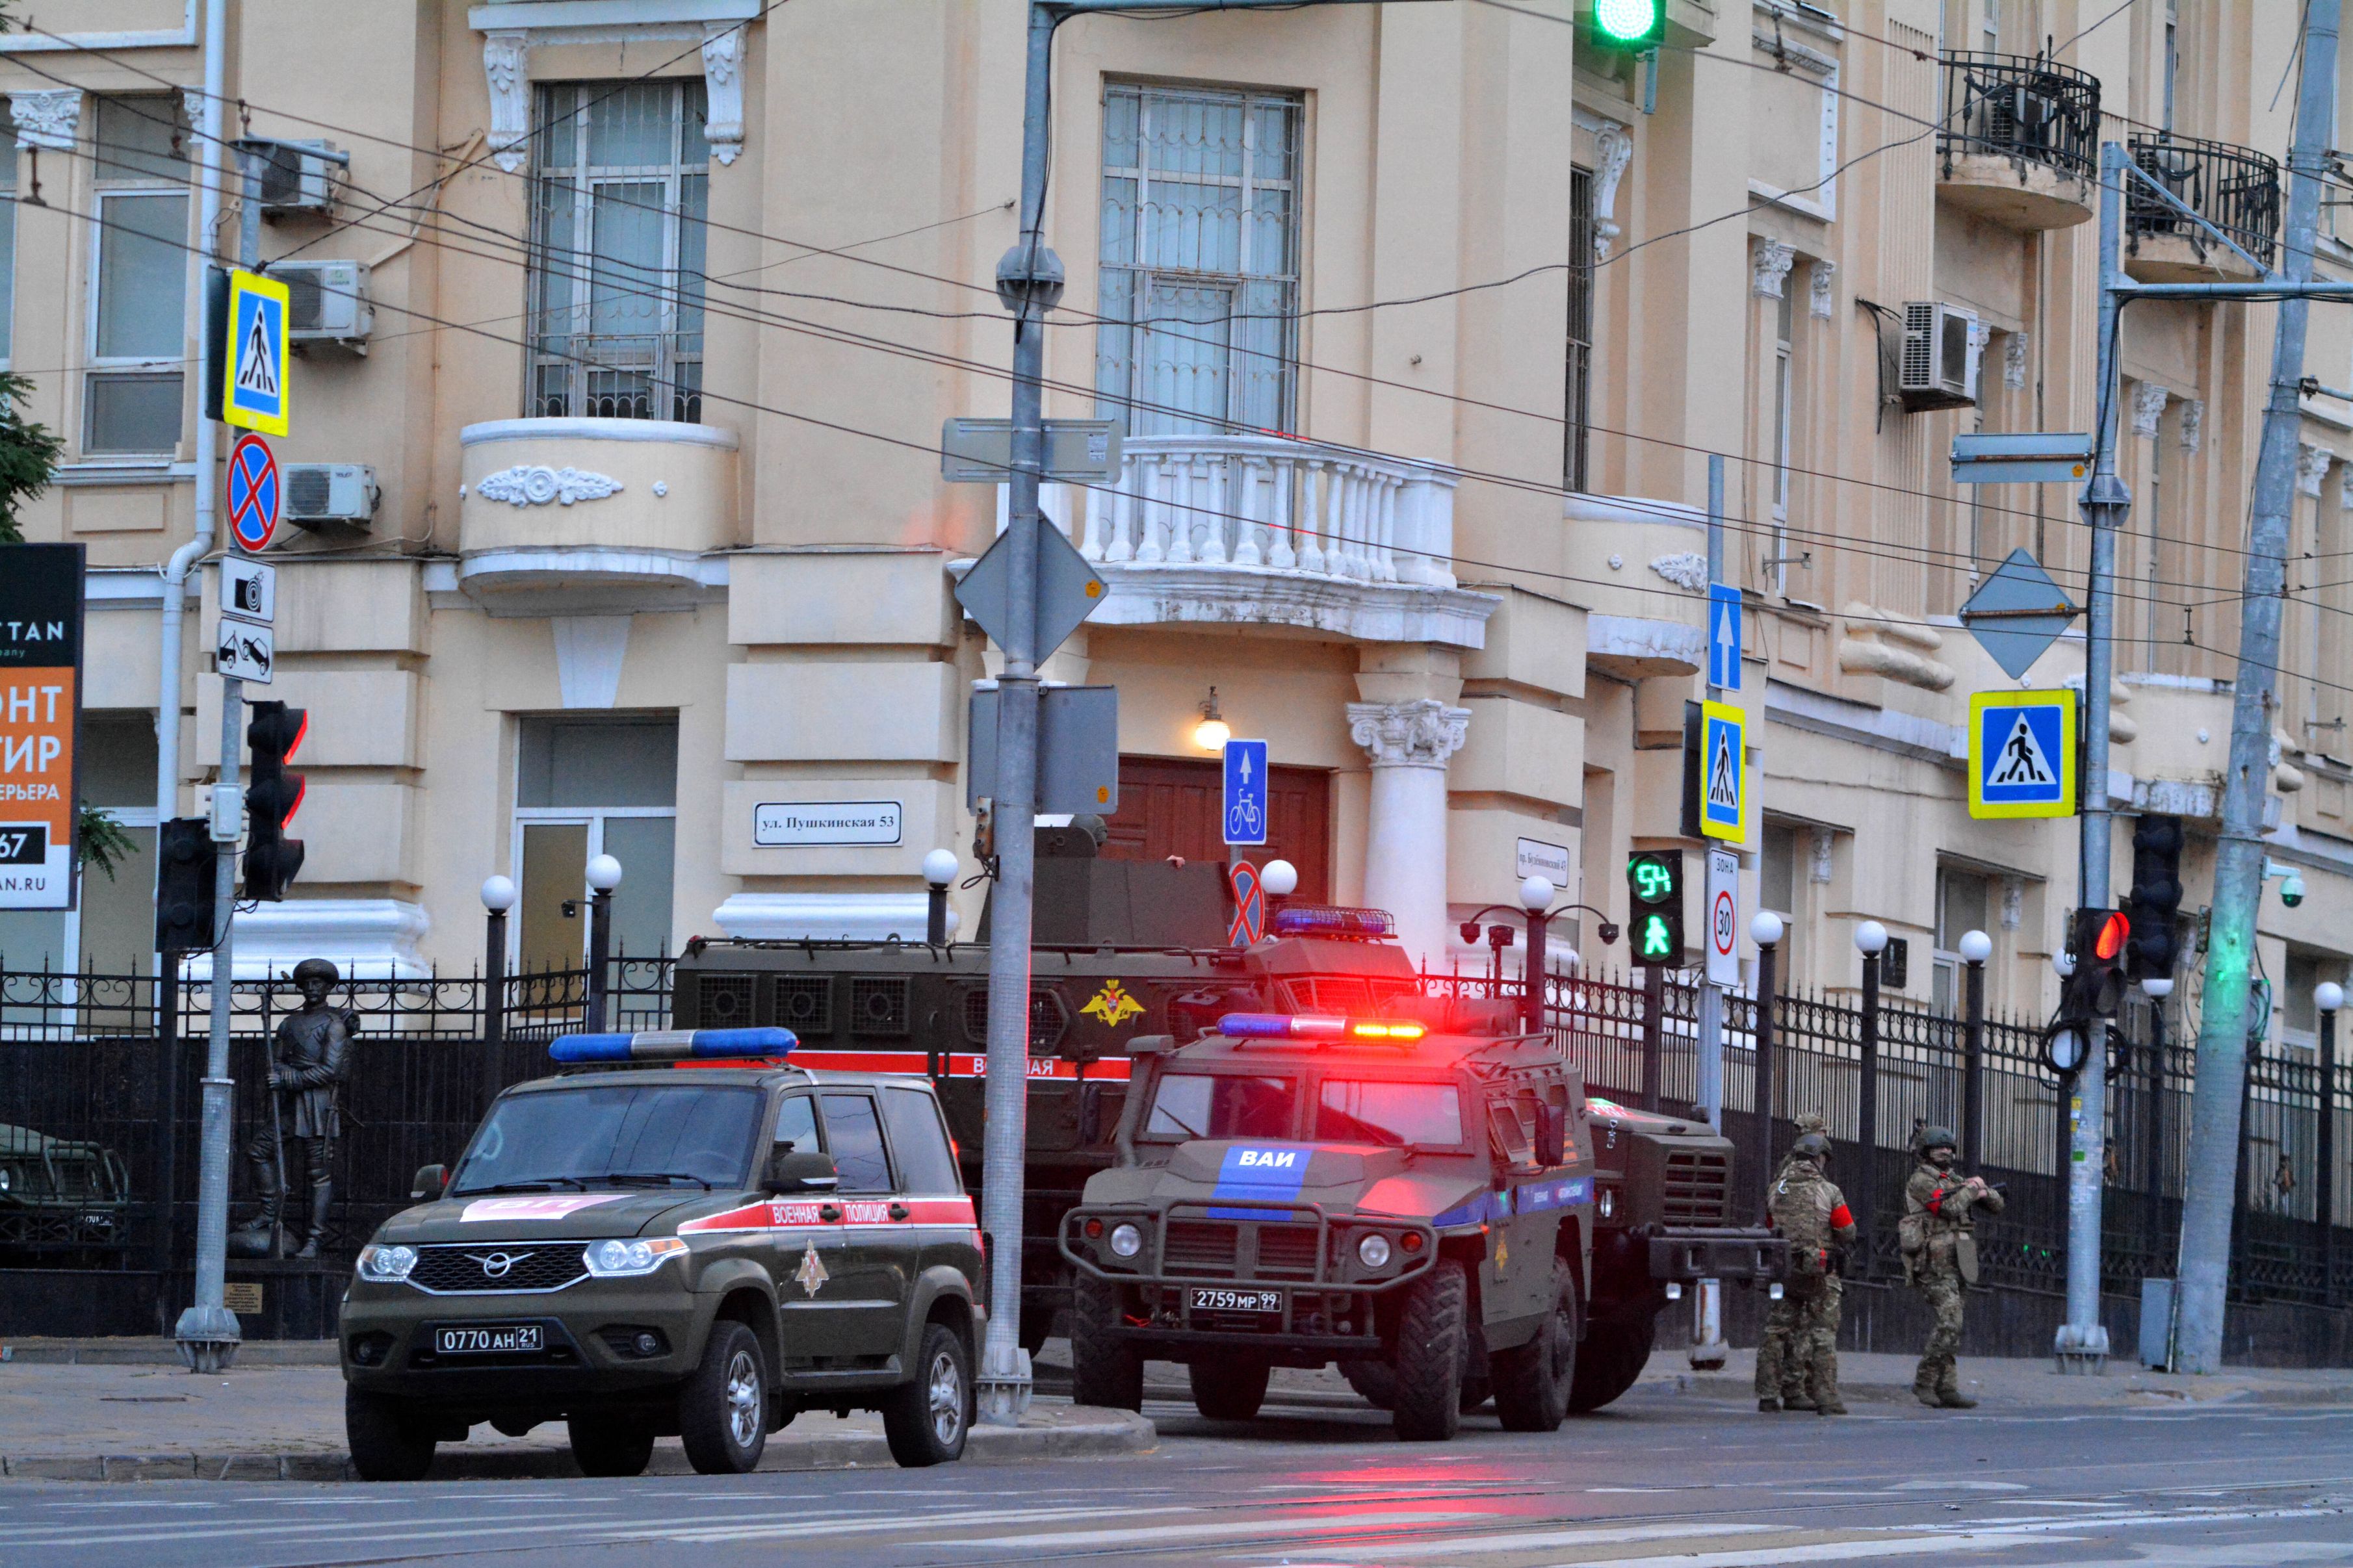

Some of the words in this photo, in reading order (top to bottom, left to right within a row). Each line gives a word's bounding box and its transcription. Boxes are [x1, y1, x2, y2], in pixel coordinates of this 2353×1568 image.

[0, 621, 64, 641] TAN
[0, 650, 25, 658] any
[0, 686, 63, 723] НТ
[0, 735, 61, 773] ИР
[762, 819, 782, 832] ул.
[786, 817, 875, 831] Пушкинская
[879, 816, 894, 828] 53
[0, 833, 27, 858] 67
[1716, 857, 1734, 875] ЗОНА
[0, 877, 45, 891] N.RU
[1637, 864, 1672, 897] 54
[1718, 910, 1730, 936] 30
[1238, 1151, 1296, 1168] ВАИ
[486, 1200, 582, 1210] ВП
[772, 1205, 820, 1224] ВОЕННАЯ
[845, 1204, 889, 1223] ПОЛИЦИЯ
[1197, 1291, 1235, 1307] 2759
[1238, 1296, 1256, 1308] МР
[1261, 1293, 1277, 1305] 99
[444, 1331, 489, 1350] 0770
[493, 1333, 514, 1348] АН
[519, 1328, 537, 1343] 21
